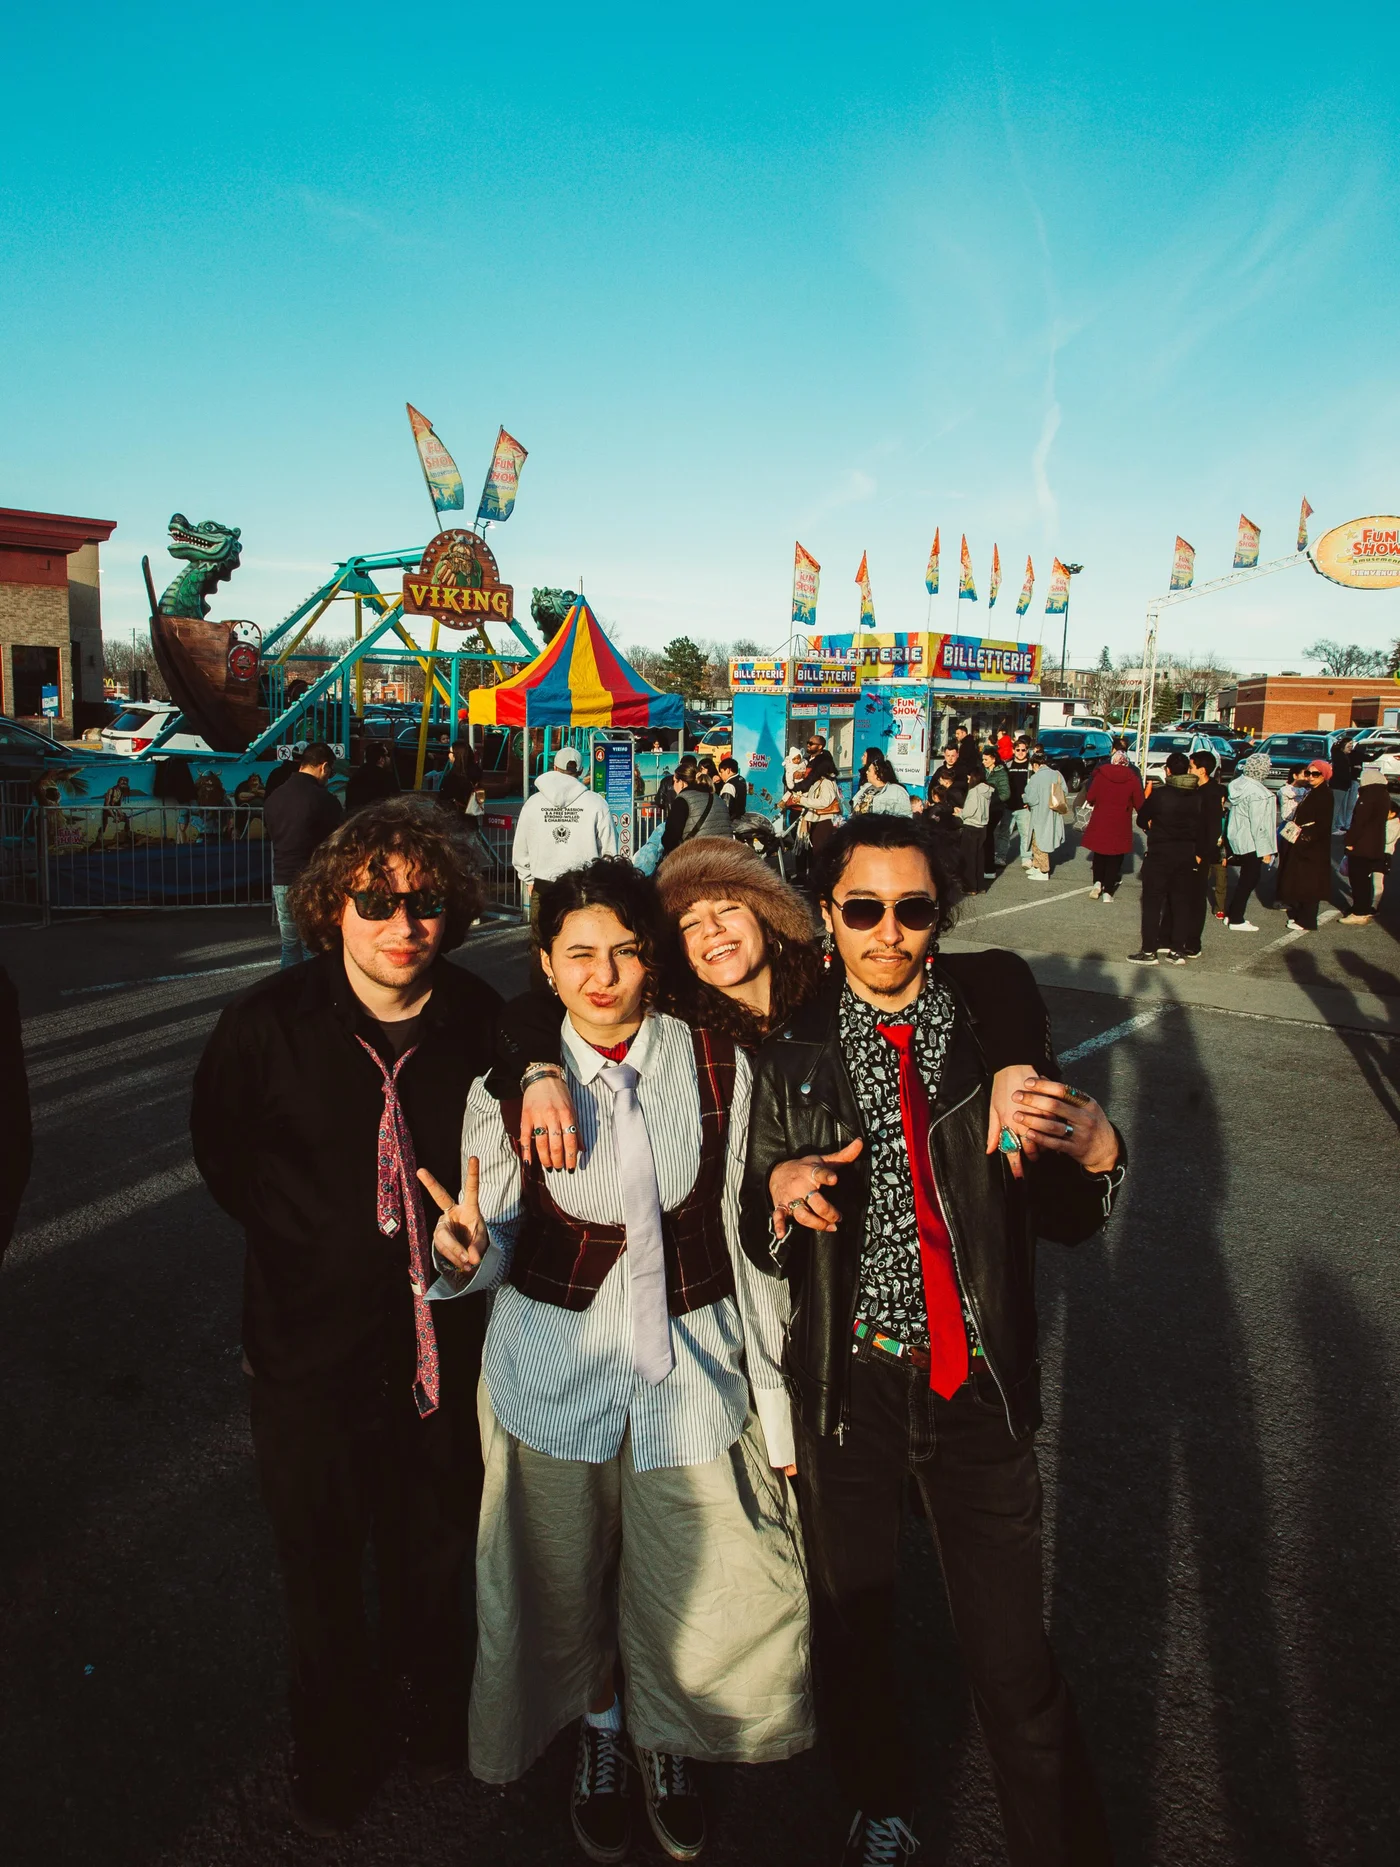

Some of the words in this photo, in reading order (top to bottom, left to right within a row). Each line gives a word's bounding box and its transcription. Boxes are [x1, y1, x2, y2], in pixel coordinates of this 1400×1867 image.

[426, 441, 445, 455] FU
[494, 457, 515, 470] FUN
[489, 471, 517, 483] HOW
[1362, 529, 1397, 543] FUN
[409, 584, 509, 618] VIKING
[943, 643, 1032, 674] BILLETTERIE
[733, 669, 785, 680] BILLETTERIE
[797, 669, 856, 682] BILLETTERIE
[897, 698, 915, 707] FUN
[893, 706, 918, 715] SHOW
[752, 753, 766, 761] FUN
[488, 817, 506, 826] SORTIE
